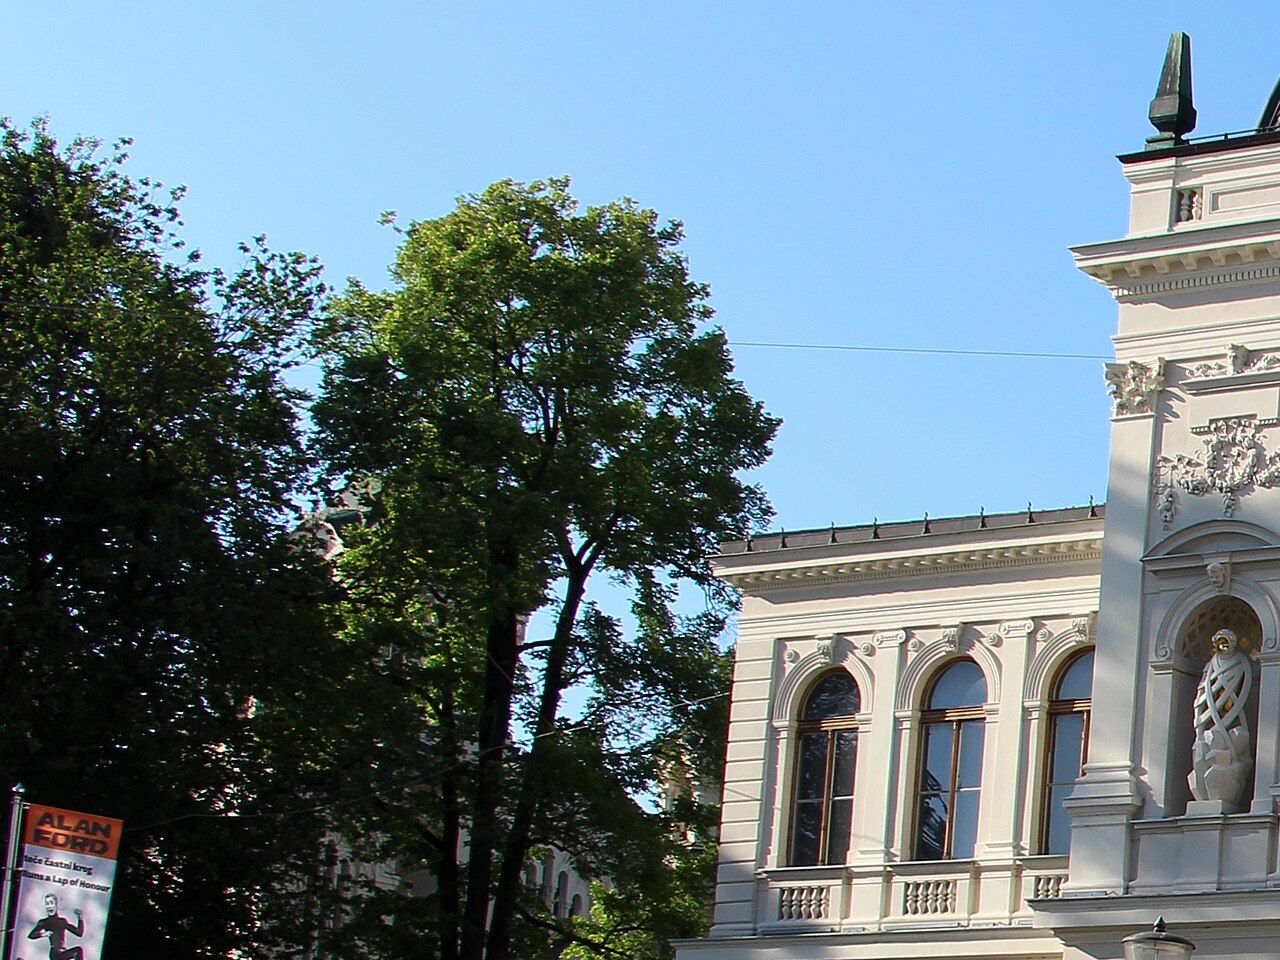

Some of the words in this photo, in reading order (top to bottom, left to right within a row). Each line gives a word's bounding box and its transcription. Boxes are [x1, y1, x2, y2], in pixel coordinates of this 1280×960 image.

[37, 812, 112, 838] ALAN
[33, 828, 110, 854] FORD
[44, 857, 72, 870] častni
[73, 862, 94, 876] krog
[53, 875, 68, 887] Lap
[69, 878, 79, 887] of
[79, 880, 111, 893] Honour
